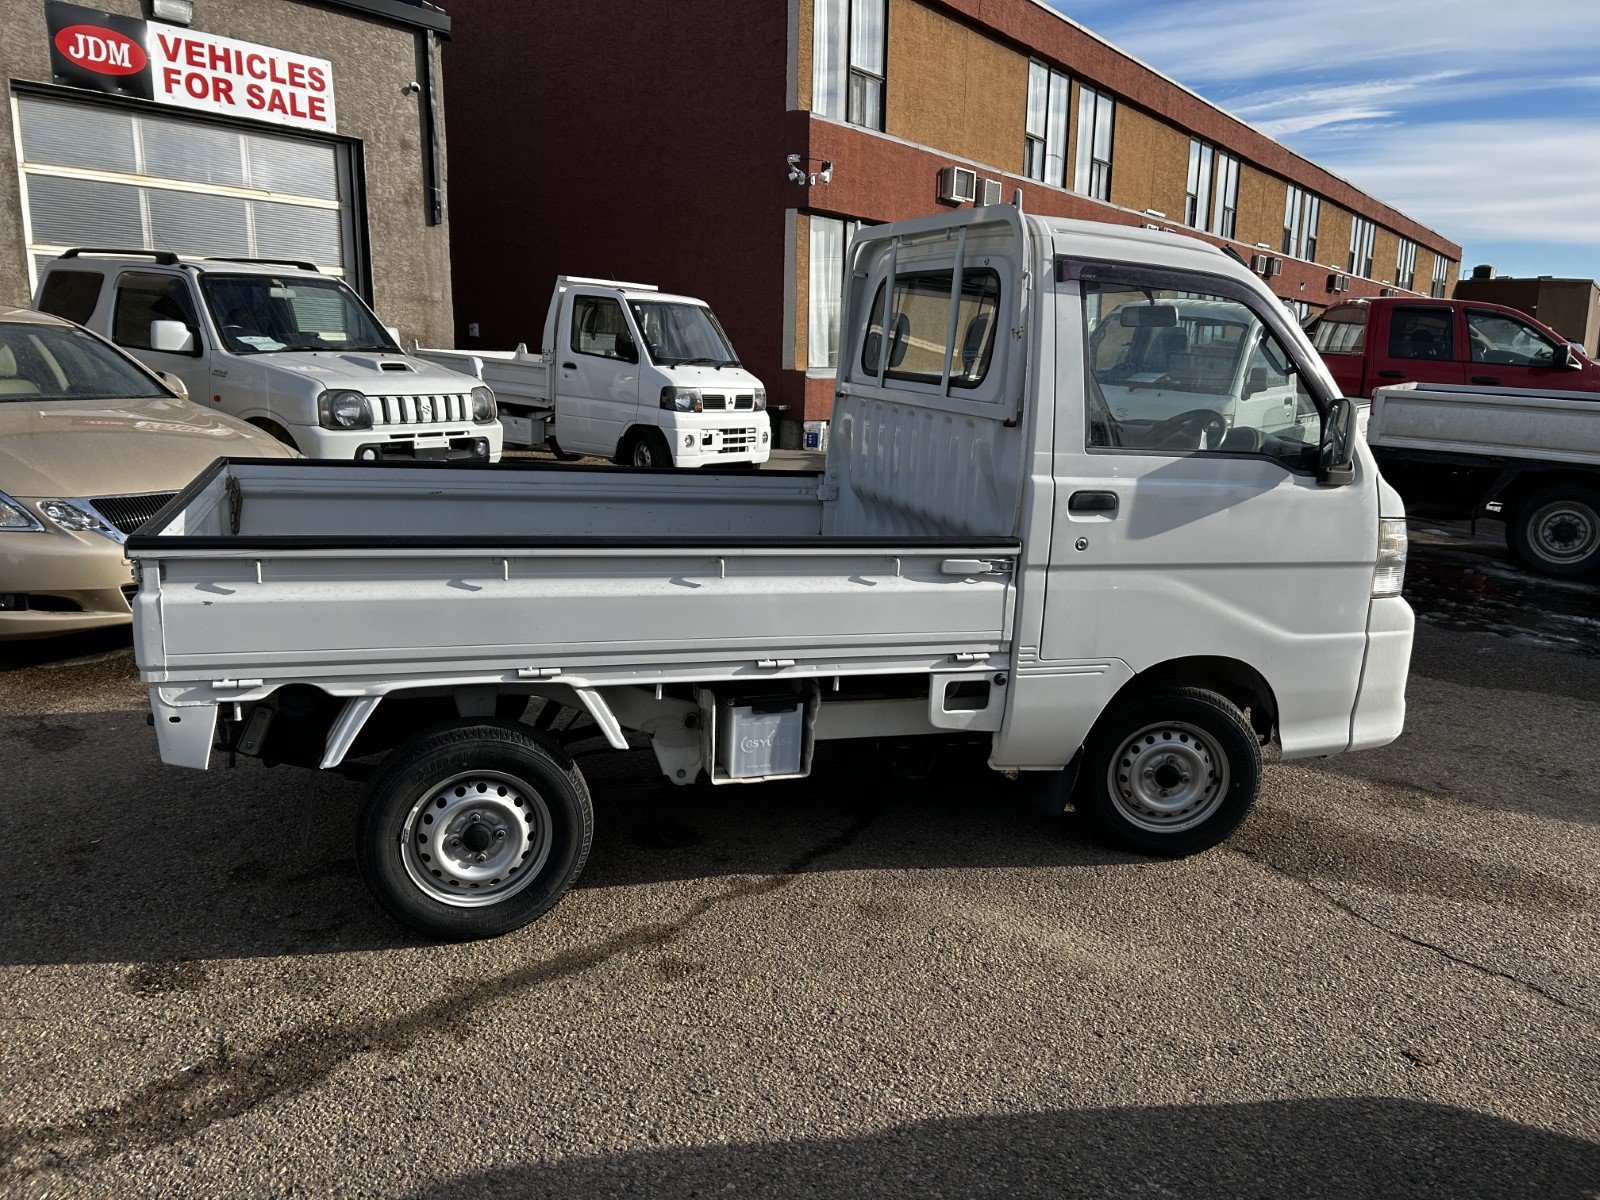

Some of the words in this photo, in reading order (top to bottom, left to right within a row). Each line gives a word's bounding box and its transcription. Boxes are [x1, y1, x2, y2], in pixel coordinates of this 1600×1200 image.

[69, 33, 132, 68] JDM
[157, 33, 327, 93] VEHICLES
[163, 67, 236, 106] FOR
[246, 84, 327, 123] SALE
